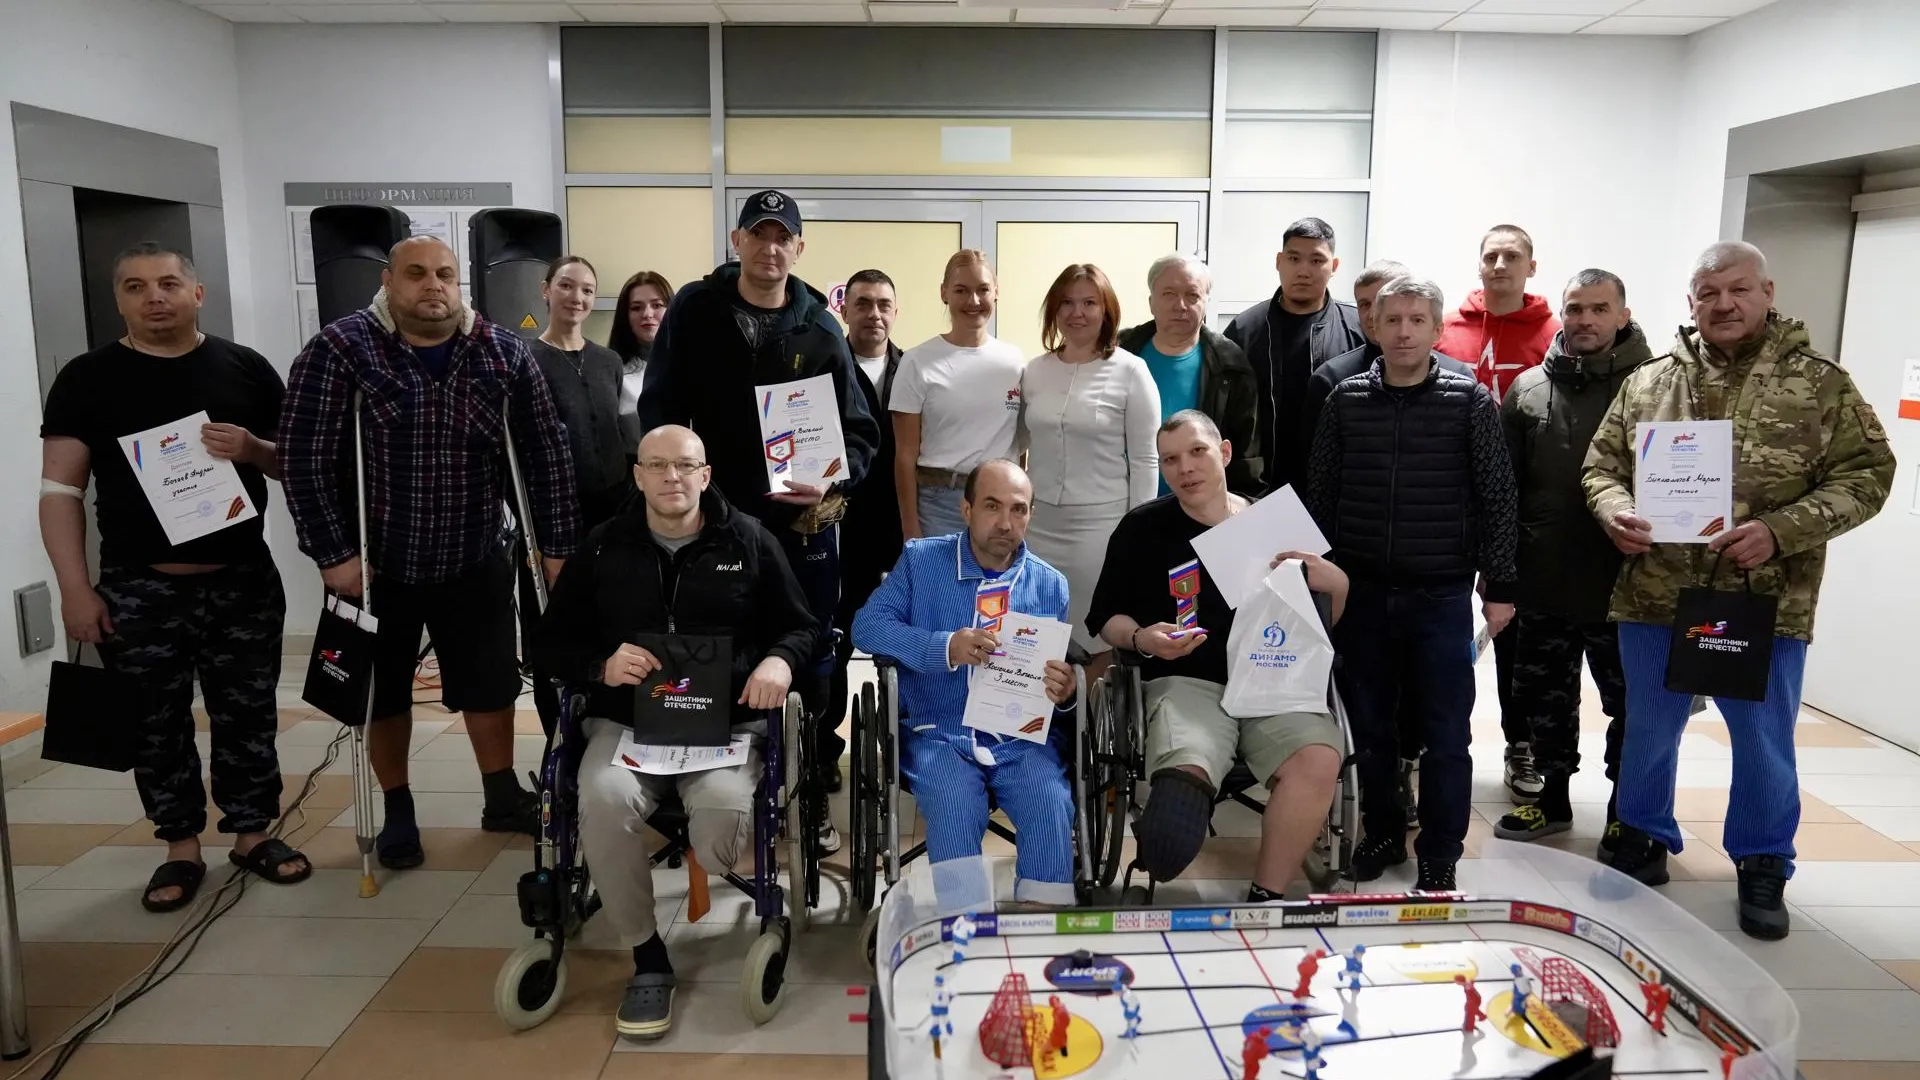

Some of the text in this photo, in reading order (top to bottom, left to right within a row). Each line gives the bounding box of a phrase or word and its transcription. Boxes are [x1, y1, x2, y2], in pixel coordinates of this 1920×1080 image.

[775, 446, 785, 456] 2
[1182, 582, 1188, 593] 1
[1699, 636, 1749, 648] ЗАЩИТНИКИ
[1698, 643, 1742, 653] ОТЕЧЕСТВА
[1249, 653, 1297, 662] ДИНАМО
[322, 665, 345, 683] ОТЕЧЕСТВА
[323, 660, 350, 679] ЗАЩИТНИКИ
[993, 672, 1003, 682] 3
[664, 695, 713, 704] ЗАЩИТНИКИ
[664, 702, 707, 710] ОТЕЧЕСТВА
[1283, 911, 1337, 925] swedol
[1059, 966, 1120, 978] SPORT
